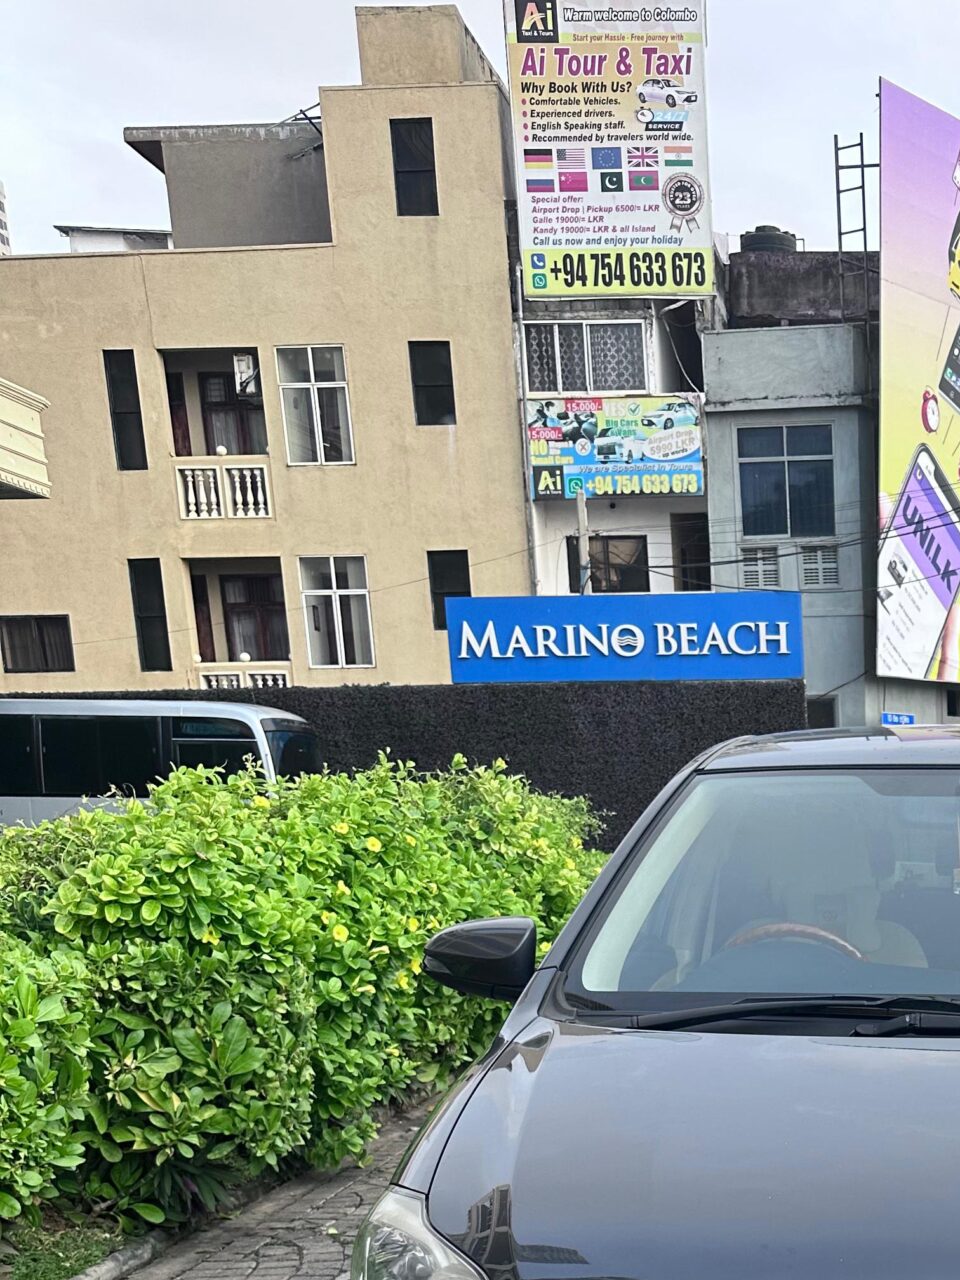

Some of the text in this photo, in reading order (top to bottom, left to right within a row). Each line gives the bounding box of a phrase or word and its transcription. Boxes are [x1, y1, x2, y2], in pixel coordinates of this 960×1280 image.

[522, 2, 554, 30] Ai
[563, 8, 697, 22] Warm welcome to Colombo
[631, 33, 644, 41] Free
[645, 34, 669, 43] journey
[670, 33, 683, 41] with
[521, 47, 693, 76] Ai Tour & Taxi
[521, 82, 632, 96] Why Book With Us?
[529, 97, 620, 105] Comfortable Vehicles.
[530, 110, 581, 119] Experienced
[531, 121, 625, 132] English Speaking staff.
[532, 133, 694, 143] Recommended by travelers world wide.
[531, 196, 560, 204] Special
[675, 192, 691, 204] 23
[532, 206, 559, 214] Airport
[587, 205, 613, 213] Pickup
[533, 216, 553, 224] Galle
[533, 226, 557, 235] Kandy
[632, 225, 656, 233] Island
[533, 236, 550, 246] Call
[552, 237, 562, 245] us
[586, 236, 601, 245] and
[604, 236, 627, 246] enjoy
[629, 237, 650, 246] your
[651, 235, 683, 246] holiday
[550, 252, 706, 287] +94 754 633 673
[648, 430, 693, 445] Airport Drop
[675, 437, 695, 448] LKR
[586, 473, 698, 495] +94 754 633 673
[457, 620, 791, 659] MARINO BEACH
